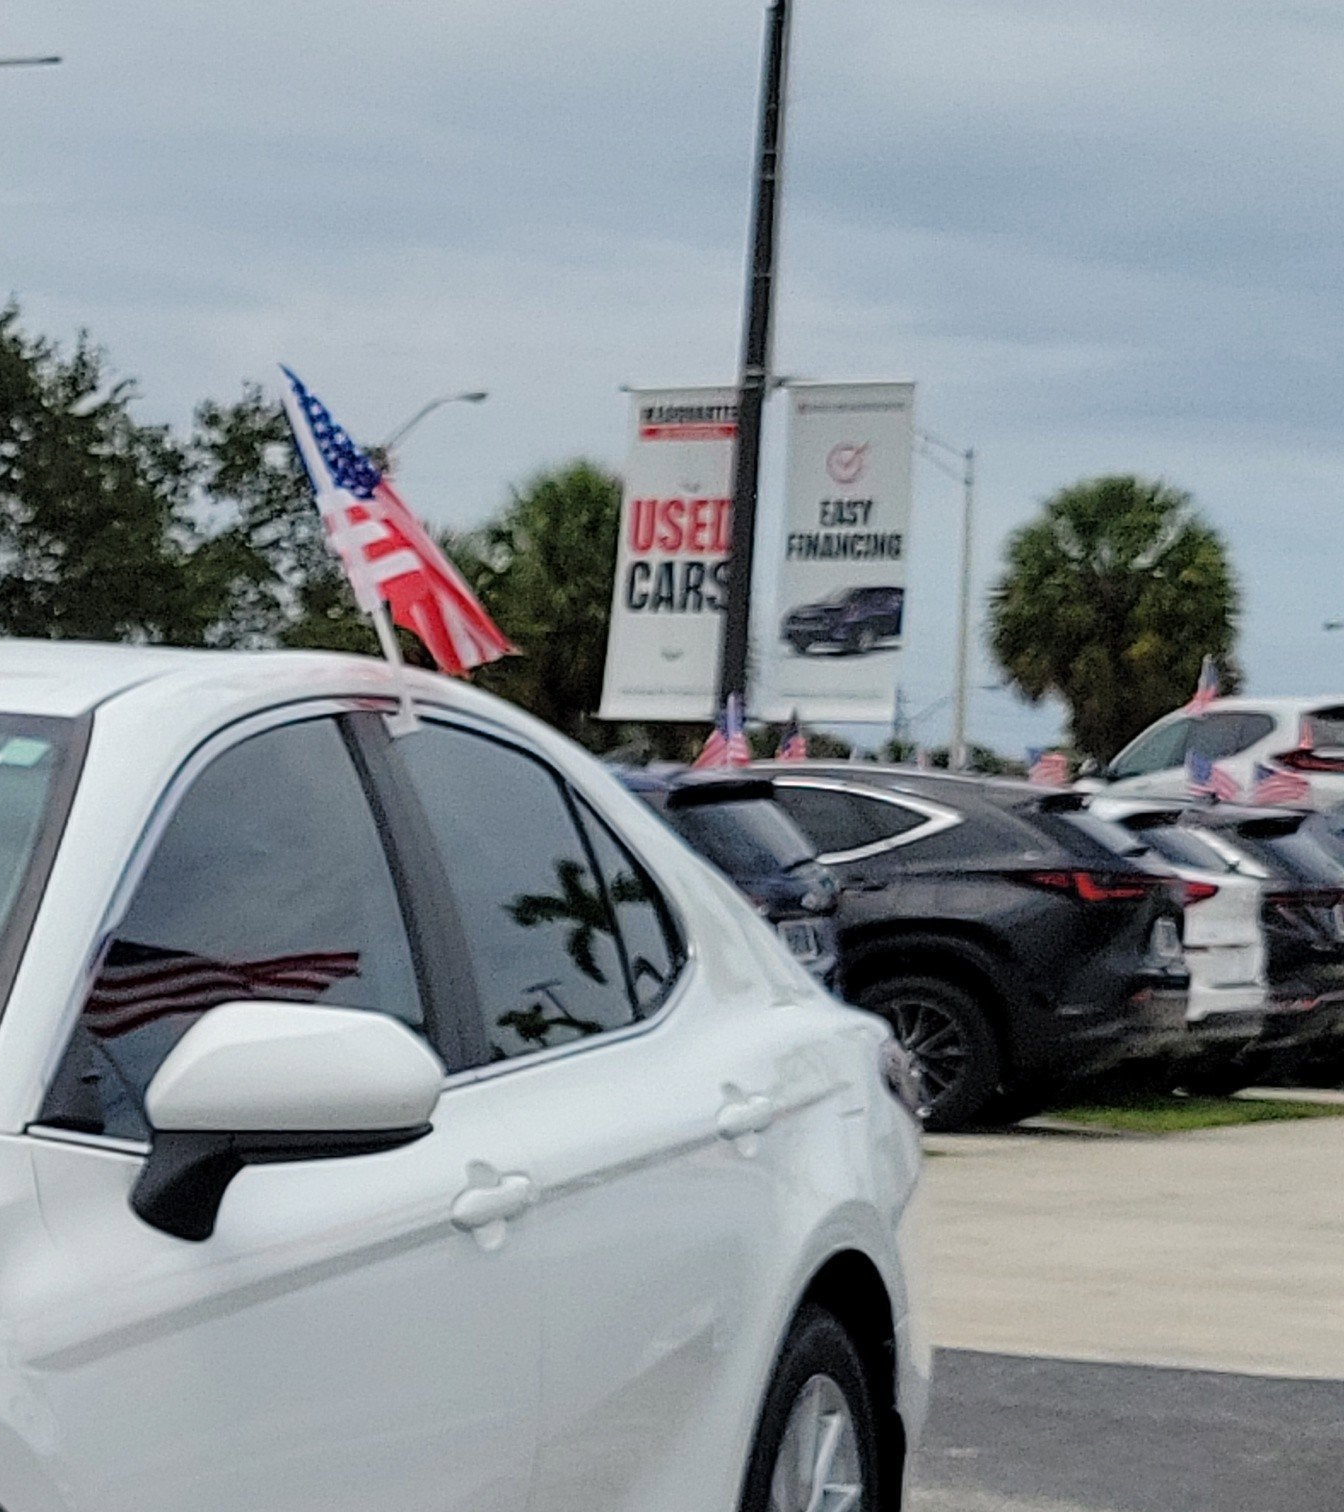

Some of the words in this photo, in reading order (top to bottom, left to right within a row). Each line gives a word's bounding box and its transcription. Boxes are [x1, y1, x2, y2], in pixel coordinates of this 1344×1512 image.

[819, 500, 873, 526] EASY
[787, 532, 903, 560] FINANCING
[626, 562, 730, 613] CARS
